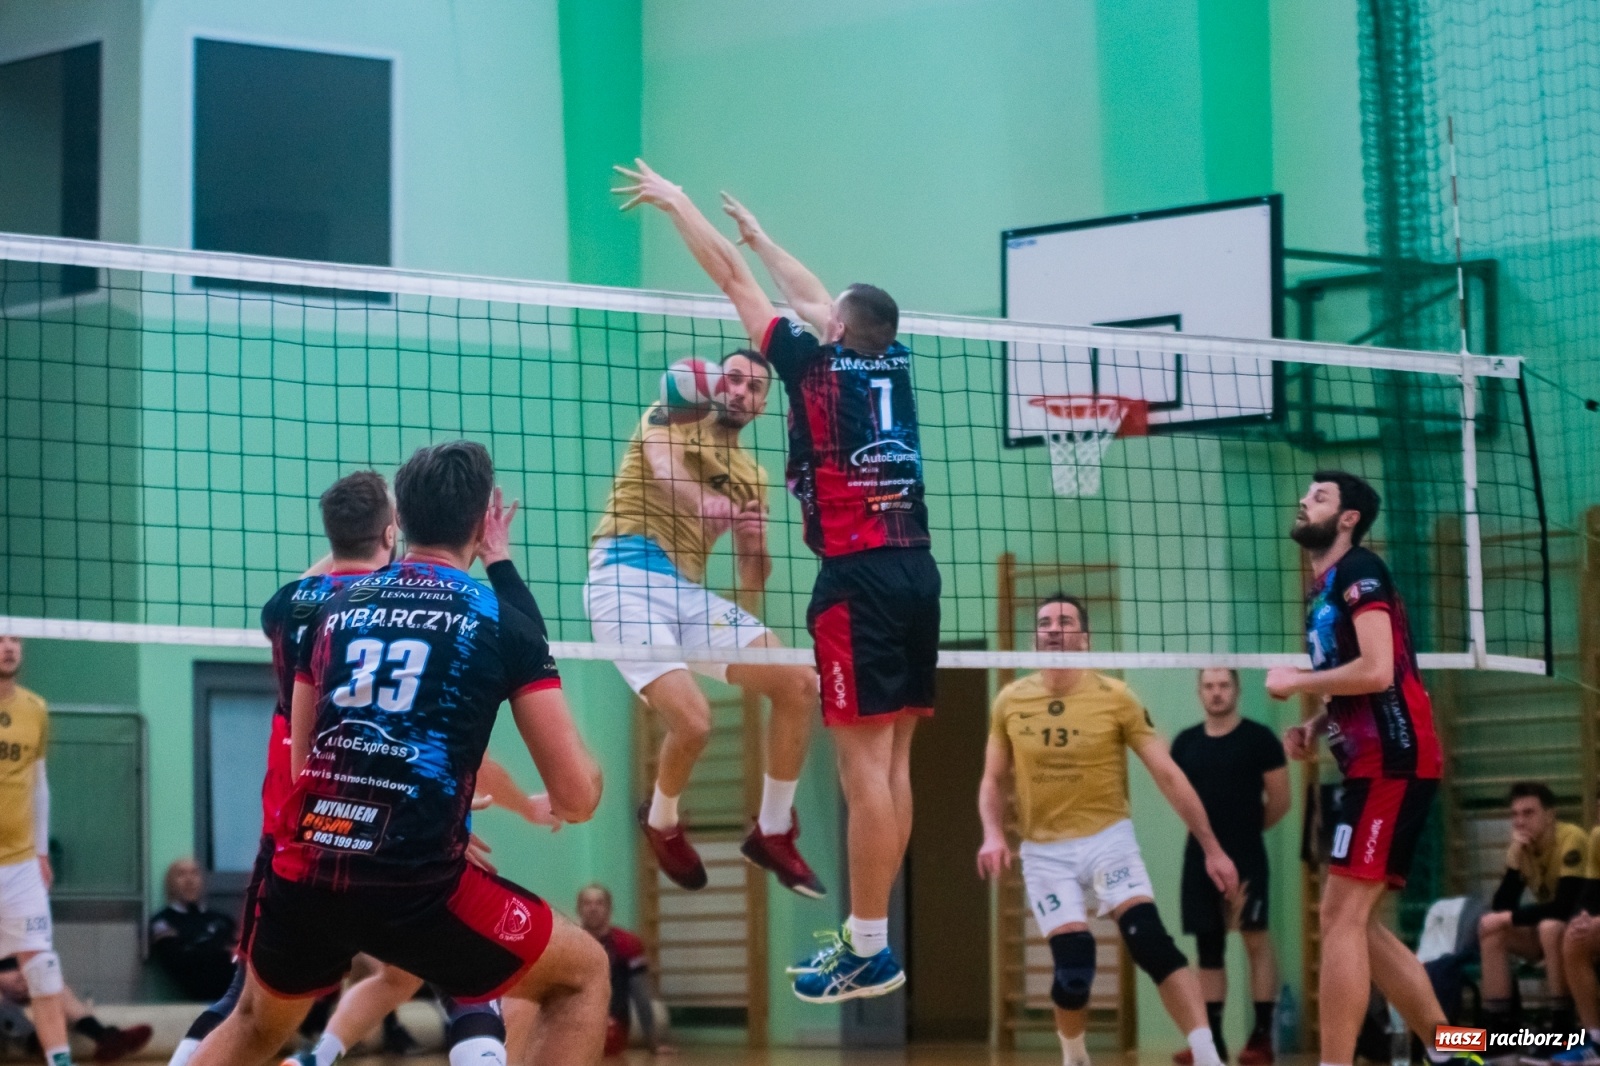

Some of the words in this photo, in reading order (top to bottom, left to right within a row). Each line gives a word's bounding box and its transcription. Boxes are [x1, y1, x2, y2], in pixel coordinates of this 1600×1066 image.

[292, 589, 336, 601] REST
[333, 637, 431, 712] 33
[1041, 727, 1069, 748] 13
[1037, 893, 1062, 917] 13
